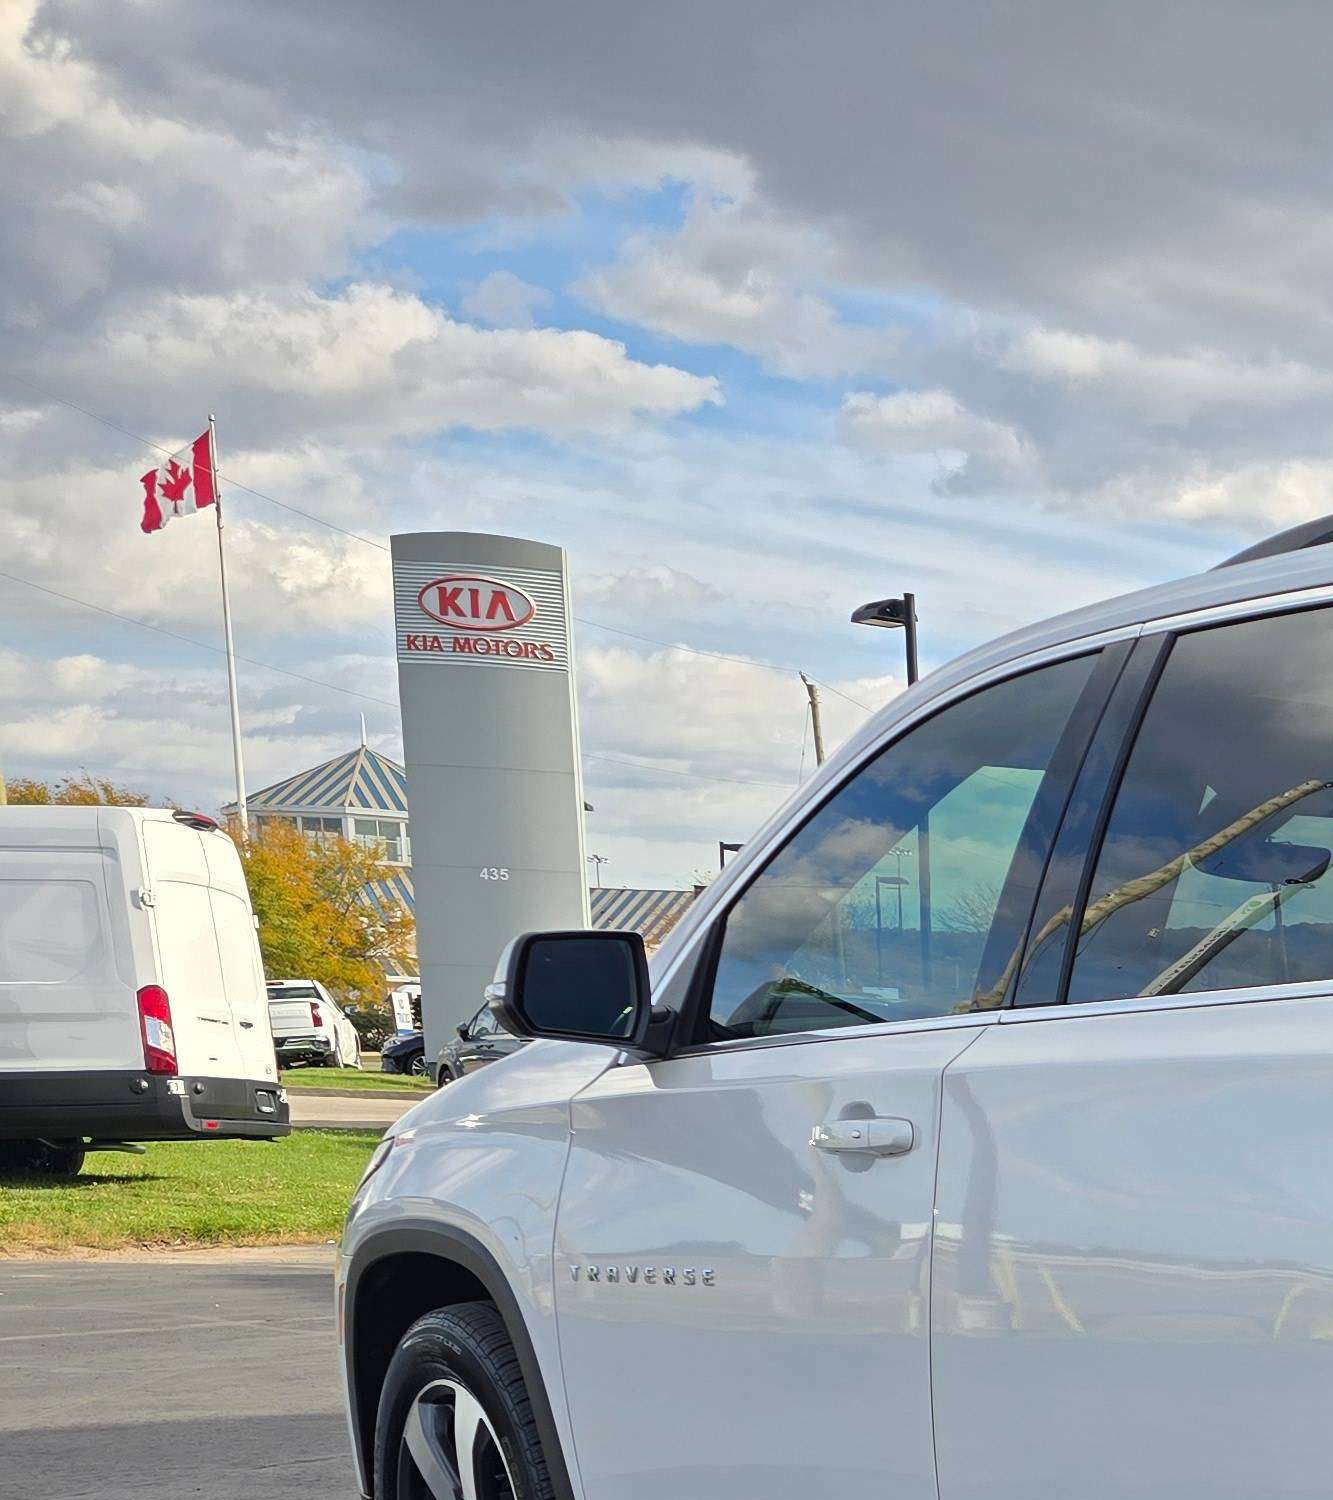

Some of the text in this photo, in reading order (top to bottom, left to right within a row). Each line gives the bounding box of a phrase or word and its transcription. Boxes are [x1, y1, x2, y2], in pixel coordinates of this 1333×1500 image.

[436, 586, 517, 622] KIA
[406, 633, 556, 662] KIA MOTORS
[479, 867, 510, 881] 435
[569, 1264, 716, 1287] TRAVERSE
